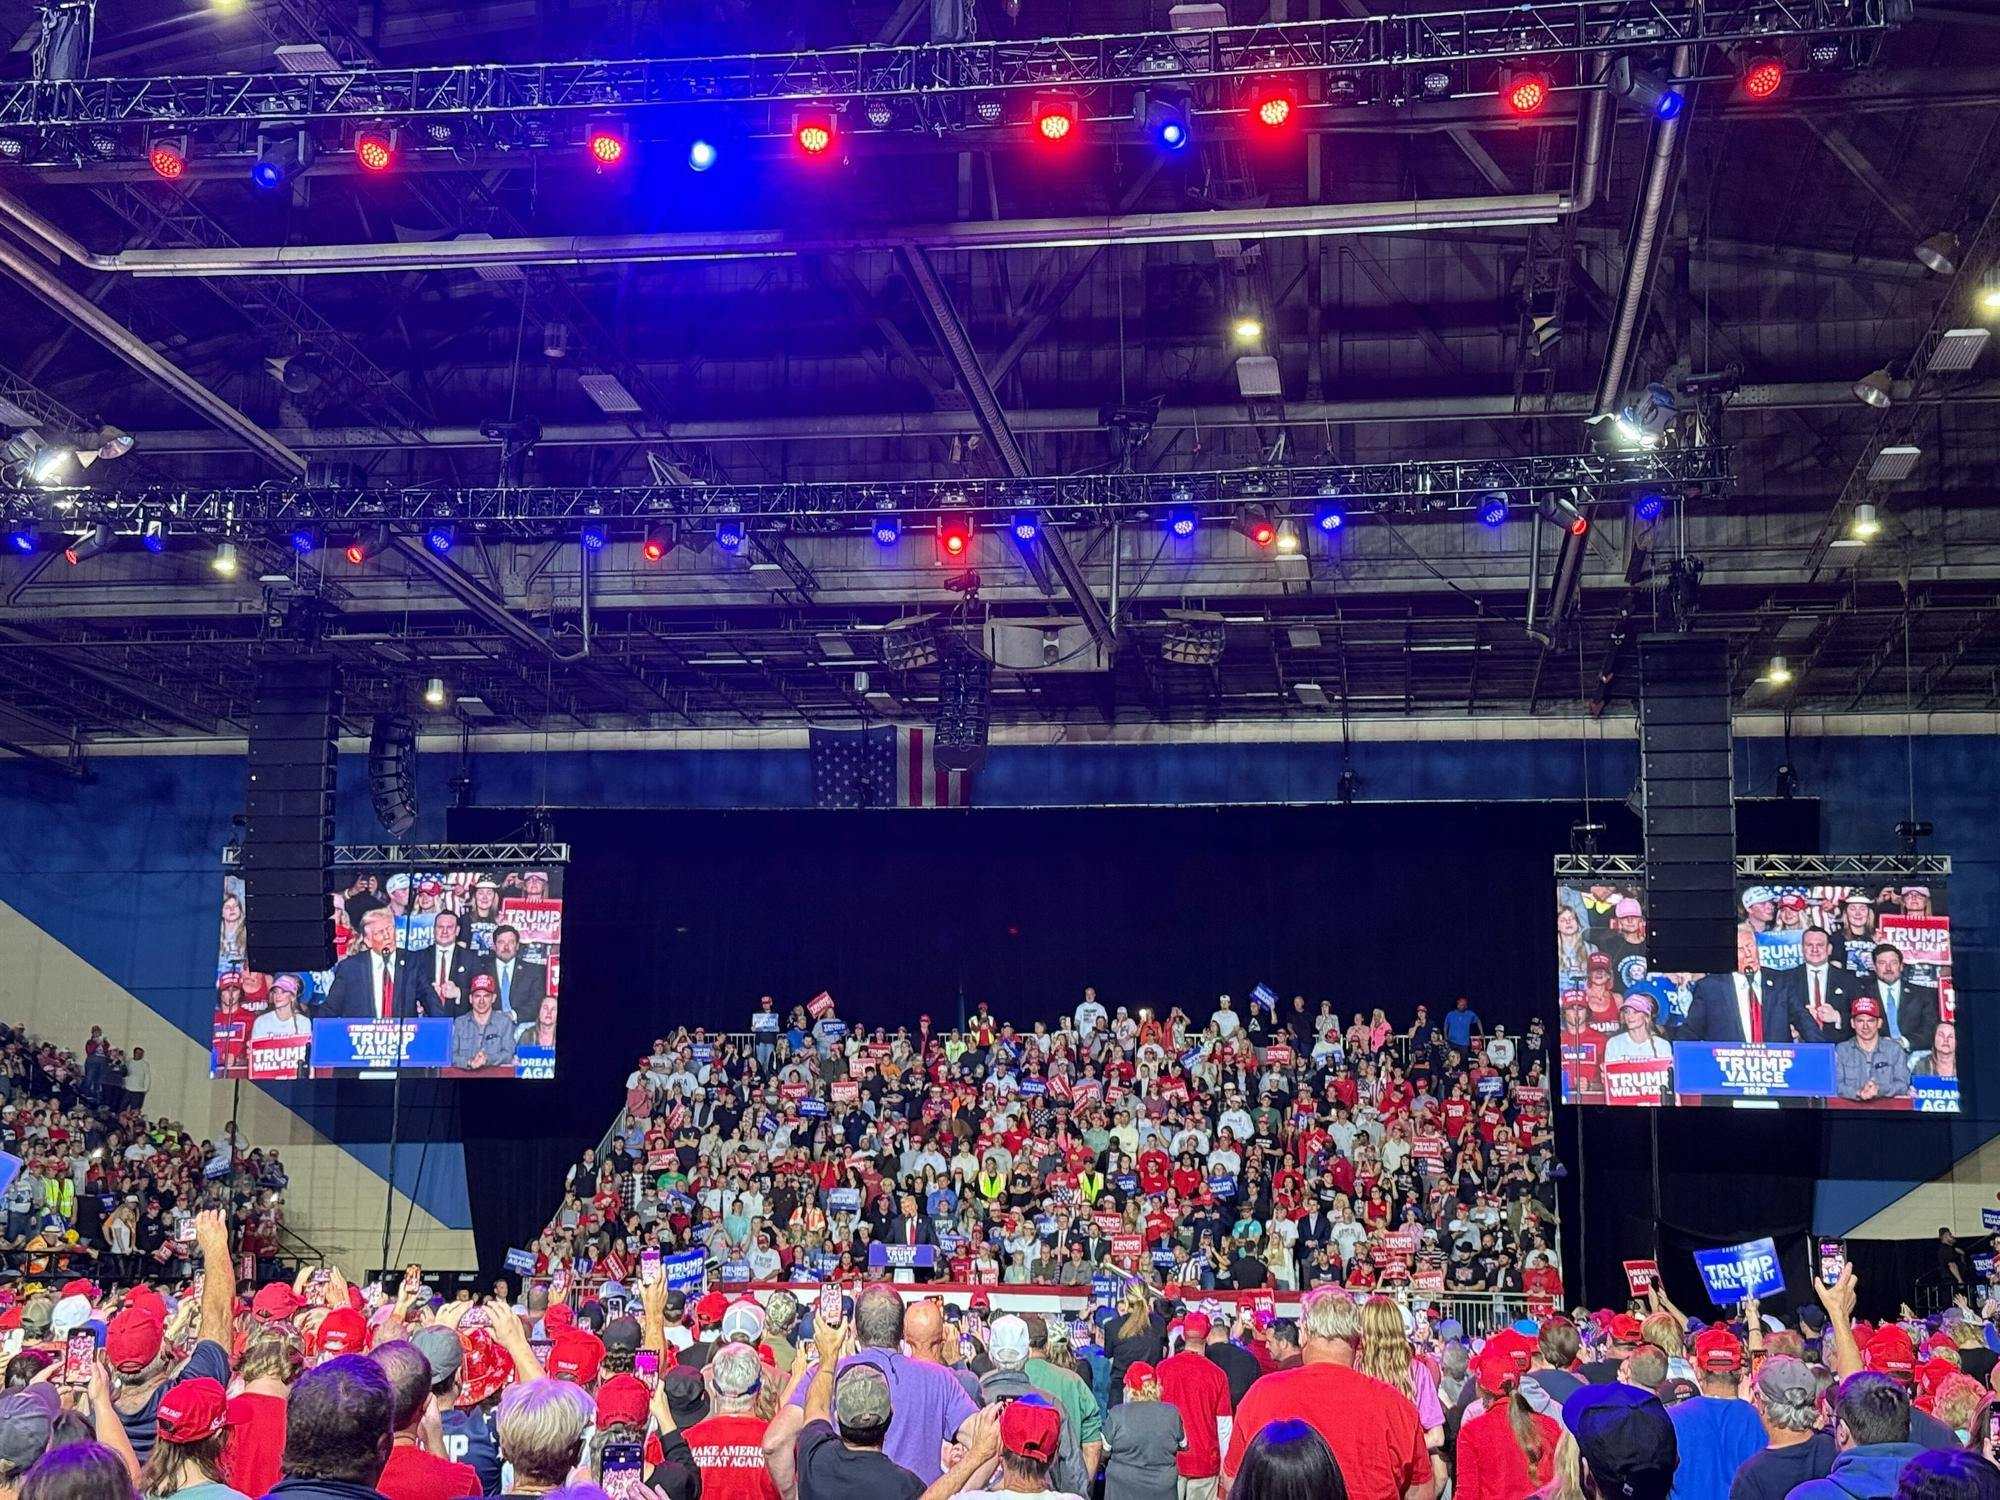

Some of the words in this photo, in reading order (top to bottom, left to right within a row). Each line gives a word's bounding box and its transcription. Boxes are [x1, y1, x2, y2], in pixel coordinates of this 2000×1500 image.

[506, 909, 561, 923] TRUMP
[1884, 928, 1949, 943] TRUMP
[348, 1032, 415, 1046] TRUMP
[253, 1060, 279, 1071] WILL
[1716, 1057, 1793, 1071] TRUMP
[521, 1067, 555, 1079] AGA
[1725, 1071, 1785, 1083] VANCE
[1610, 1085, 1640, 1097] WILL
[1920, 1099, 1960, 1112] AGA
[667, 1258, 703, 1273] TRUMP
[1704, 1255, 1773, 1280] TRUMP
[1709, 1278, 1740, 1290] WILL
[1741, 1273, 1762, 1287] FIX
[1763, 1269, 1776, 1281] IT
[558, 1361, 578, 1370] TRUMP
[694, 1456, 729, 1467] GREAT
[730, 1457, 765, 1468] AGAIN
